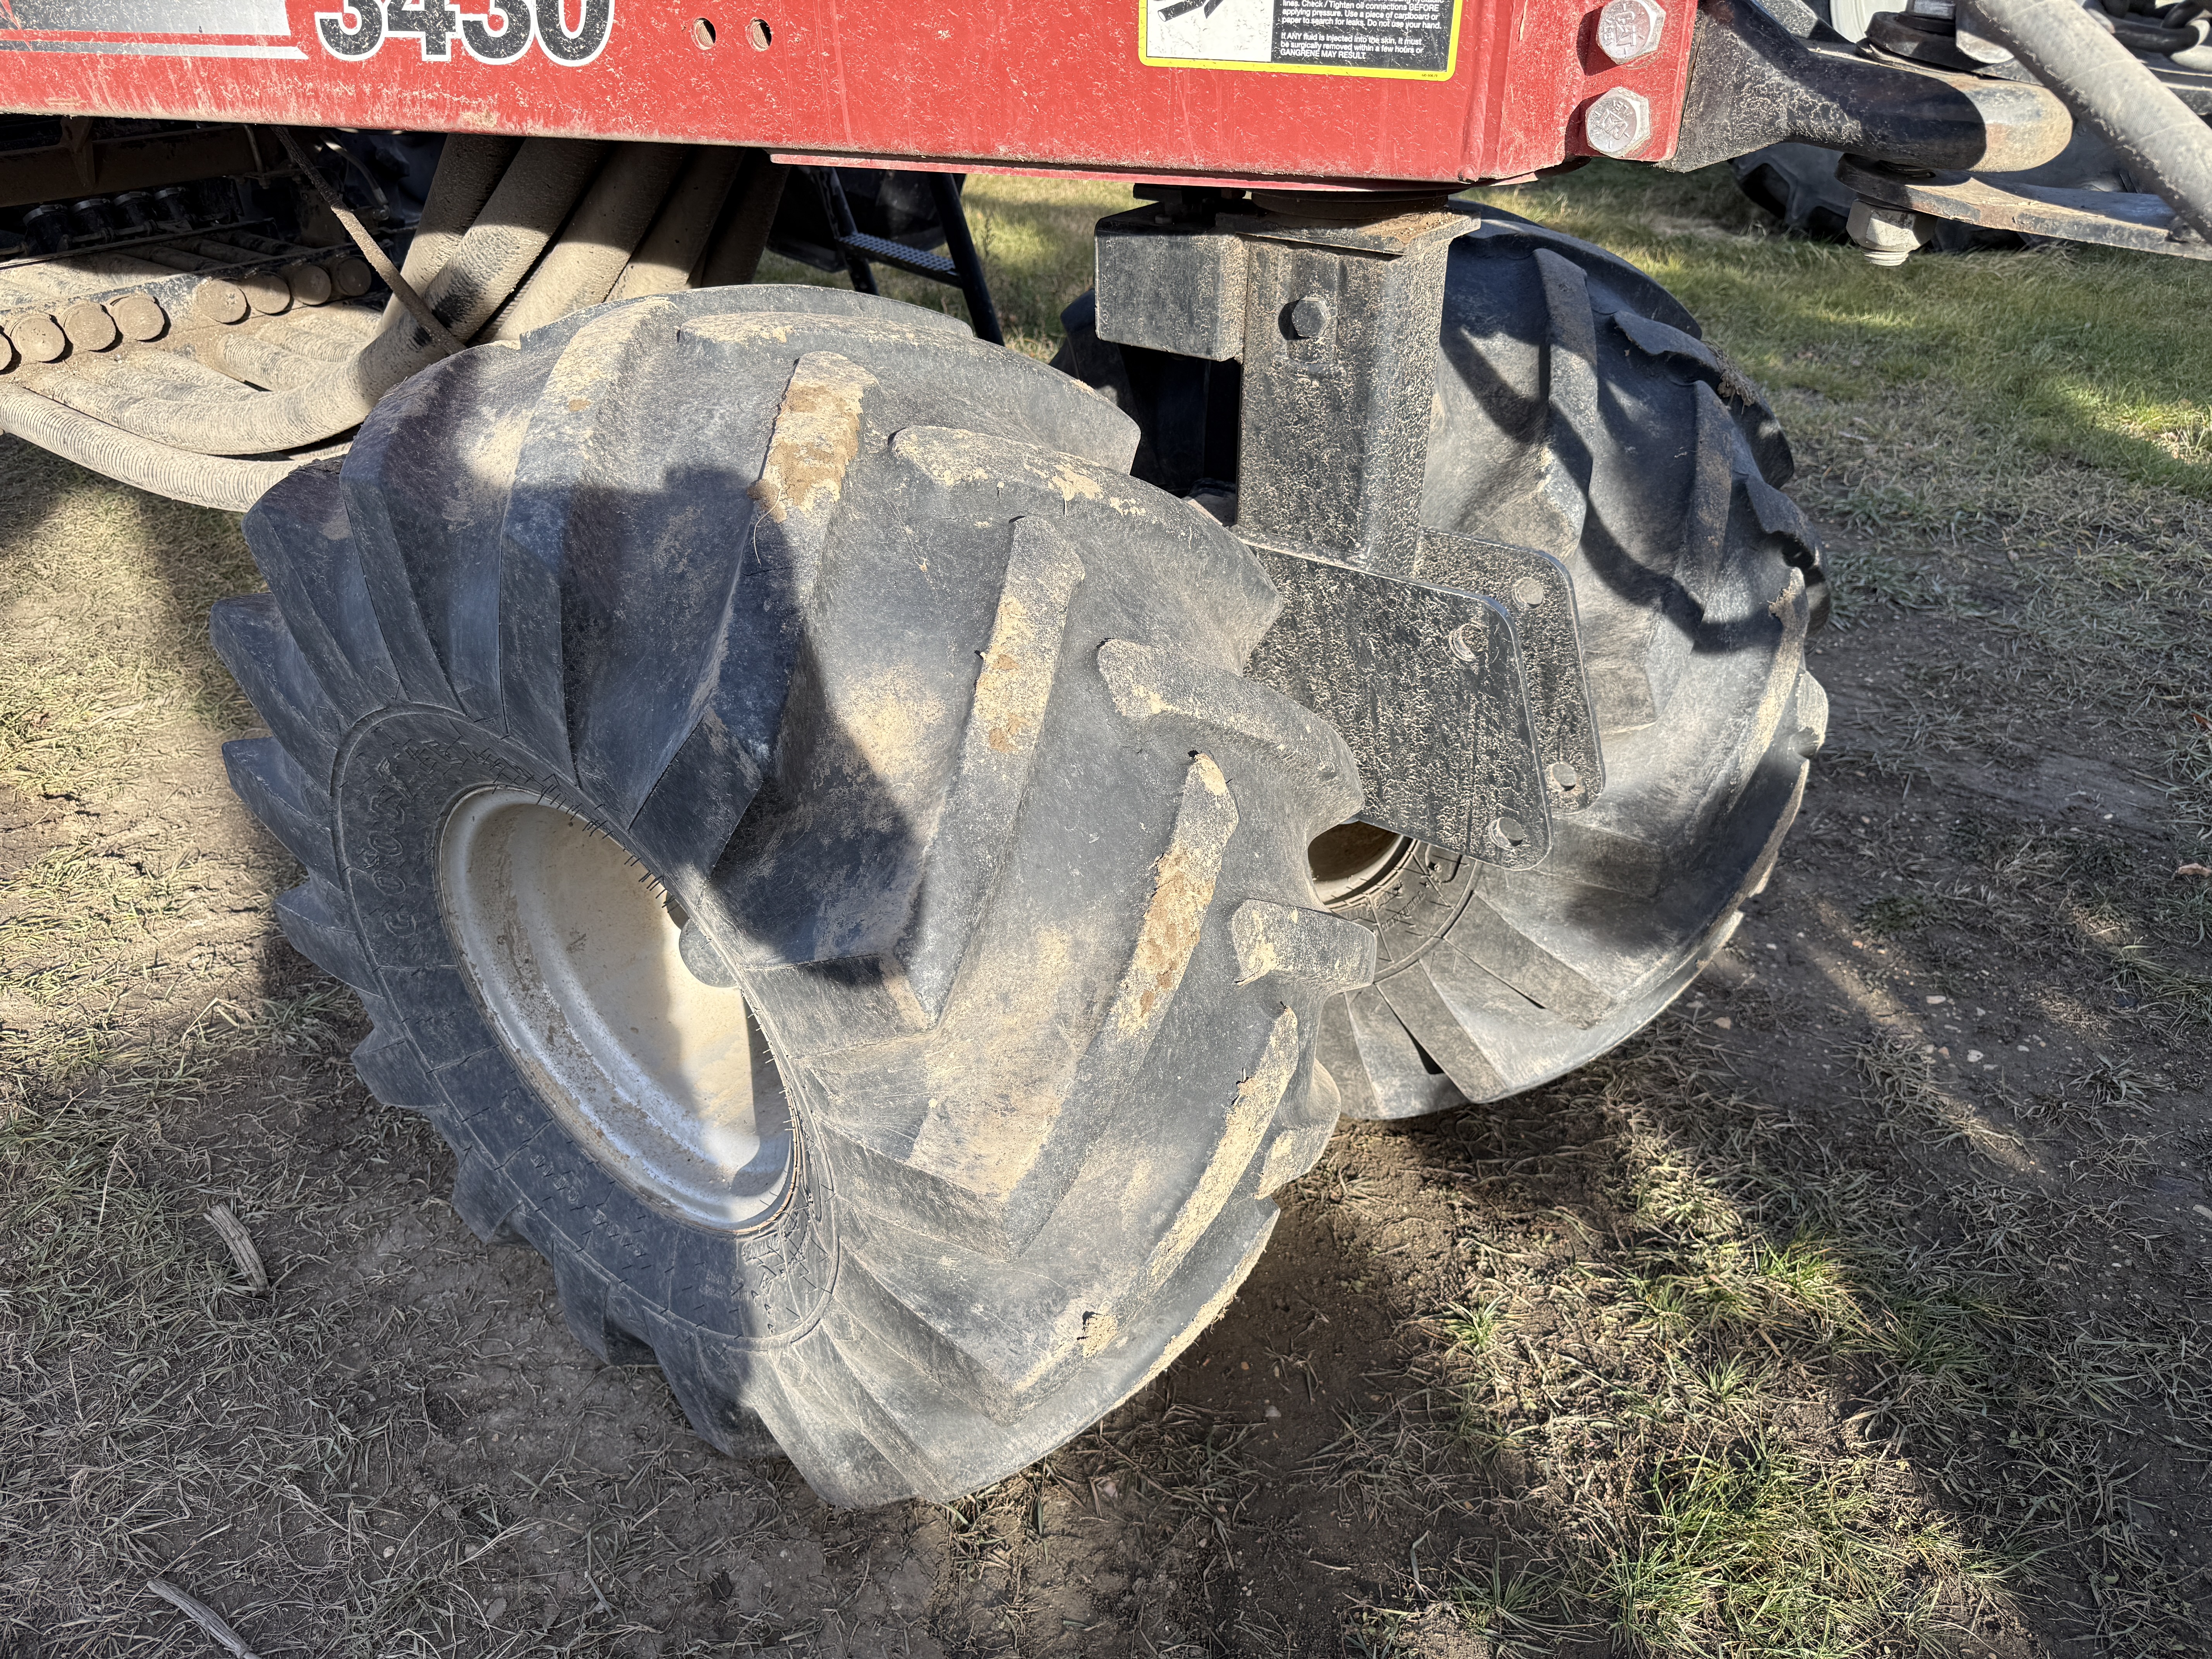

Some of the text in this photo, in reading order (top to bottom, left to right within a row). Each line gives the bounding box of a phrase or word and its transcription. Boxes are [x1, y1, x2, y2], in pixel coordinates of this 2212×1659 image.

[1329, 0, 1354, 10] Tighten
[1365, 3, 1407, 11] connections
[1409, 4, 1439, 12] BEFORE
[1282, 8, 1310, 17] applying
[1346, 18, 1365, 26] leaks.
[314, 0, 615, 67] 3430
[1326, 34, 1353, 43] injected
[1381, 37, 1396, 45] skin,
[1291, 41, 1322, 50] surgically
[1280, 48, 1320, 57] GANGRENE
